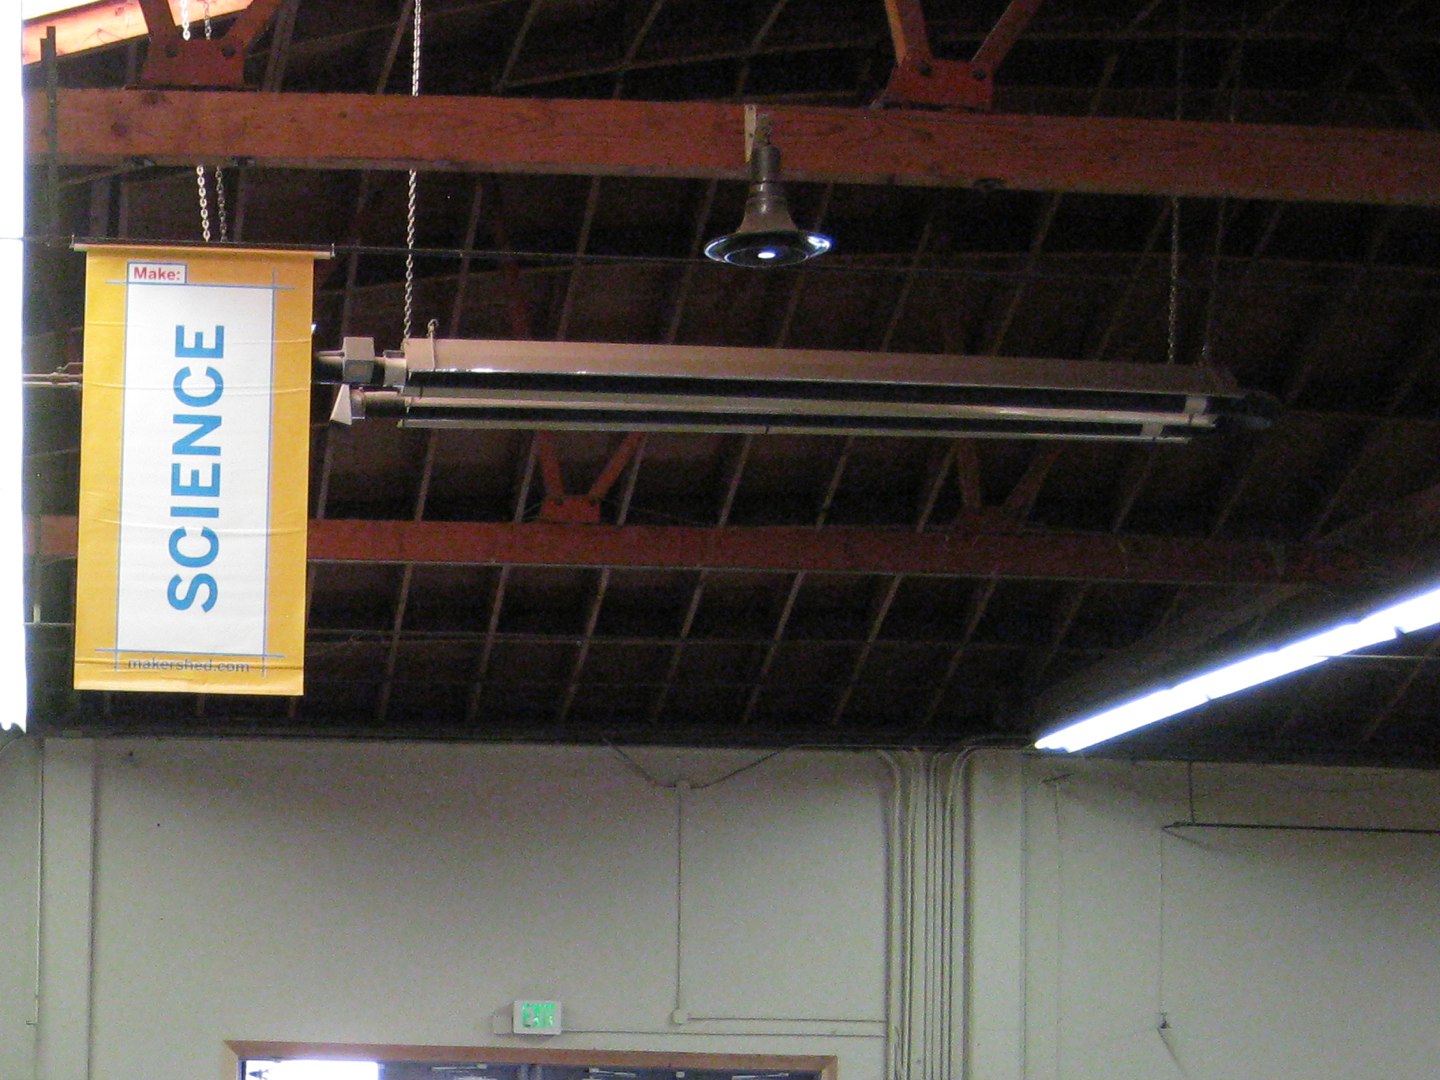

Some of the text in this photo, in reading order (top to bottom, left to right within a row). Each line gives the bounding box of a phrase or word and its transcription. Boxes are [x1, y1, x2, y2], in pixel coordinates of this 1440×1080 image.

[133, 265, 181, 282] Make:
[167, 325, 225, 614] SCIENCE
[127, 656, 250, 673] makershed.com
